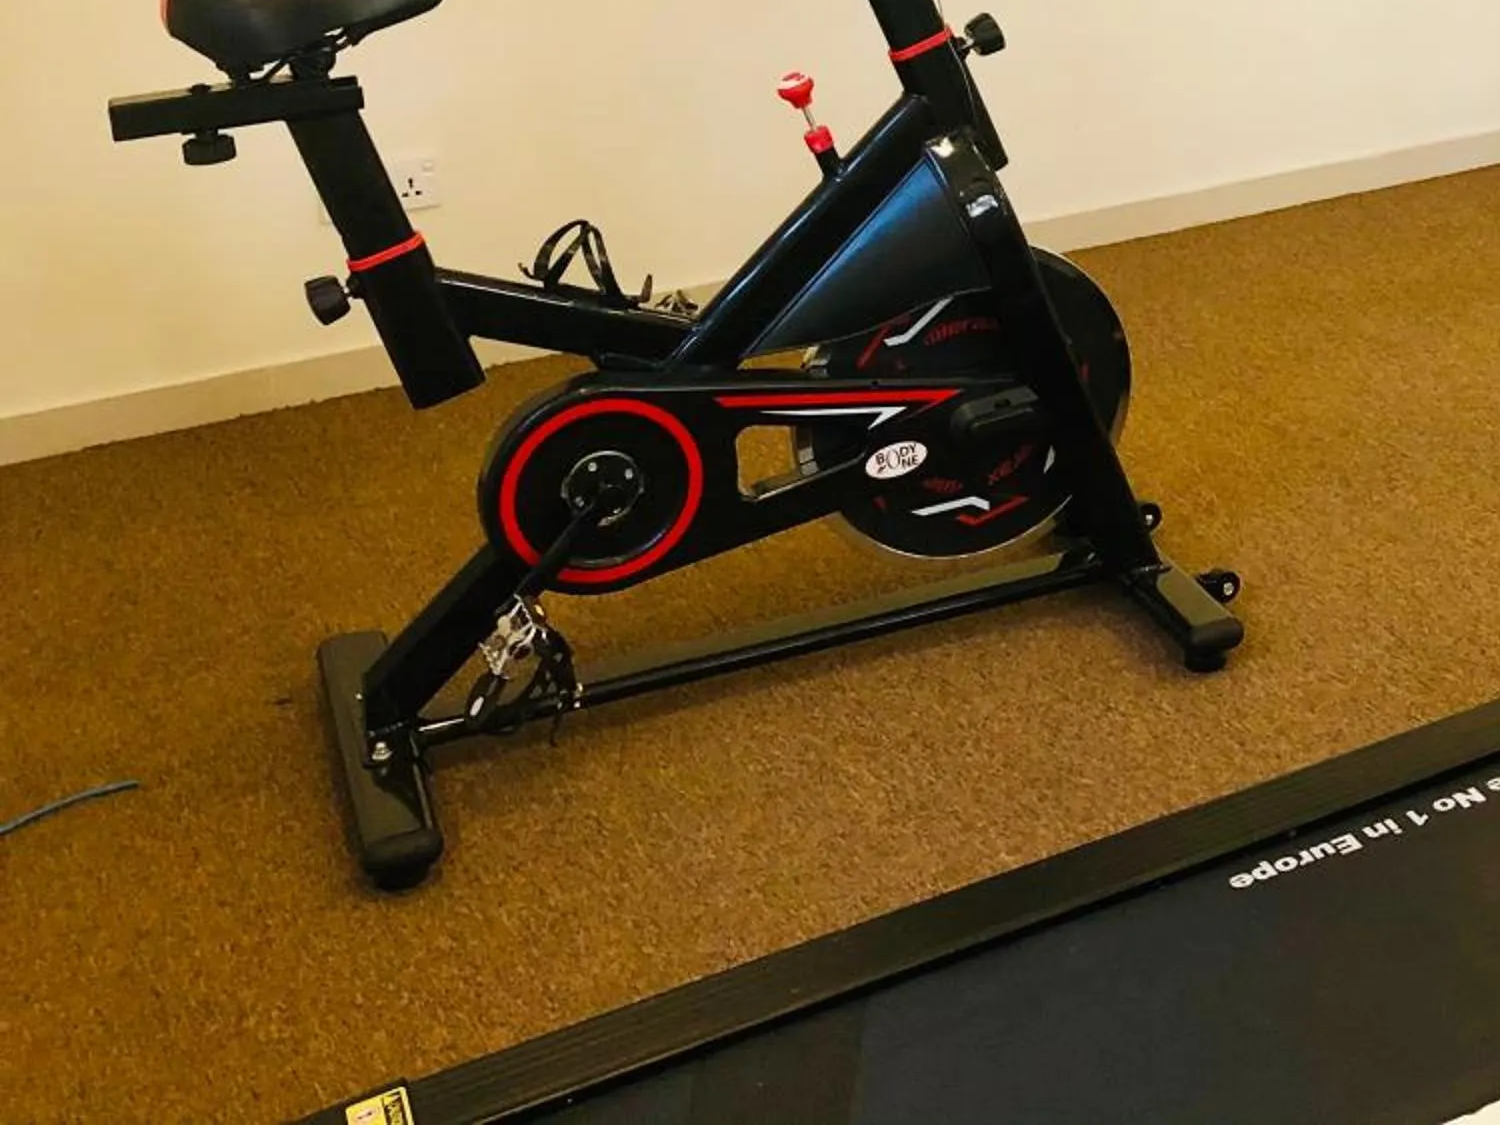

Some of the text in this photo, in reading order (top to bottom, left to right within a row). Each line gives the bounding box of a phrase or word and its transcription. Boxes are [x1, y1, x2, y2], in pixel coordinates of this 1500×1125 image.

[1432, 786, 1487, 812] No
[1361, 817, 1403, 839] in
[1405, 809, 1429, 826] 1
[1228, 832, 1364, 888] Europe
